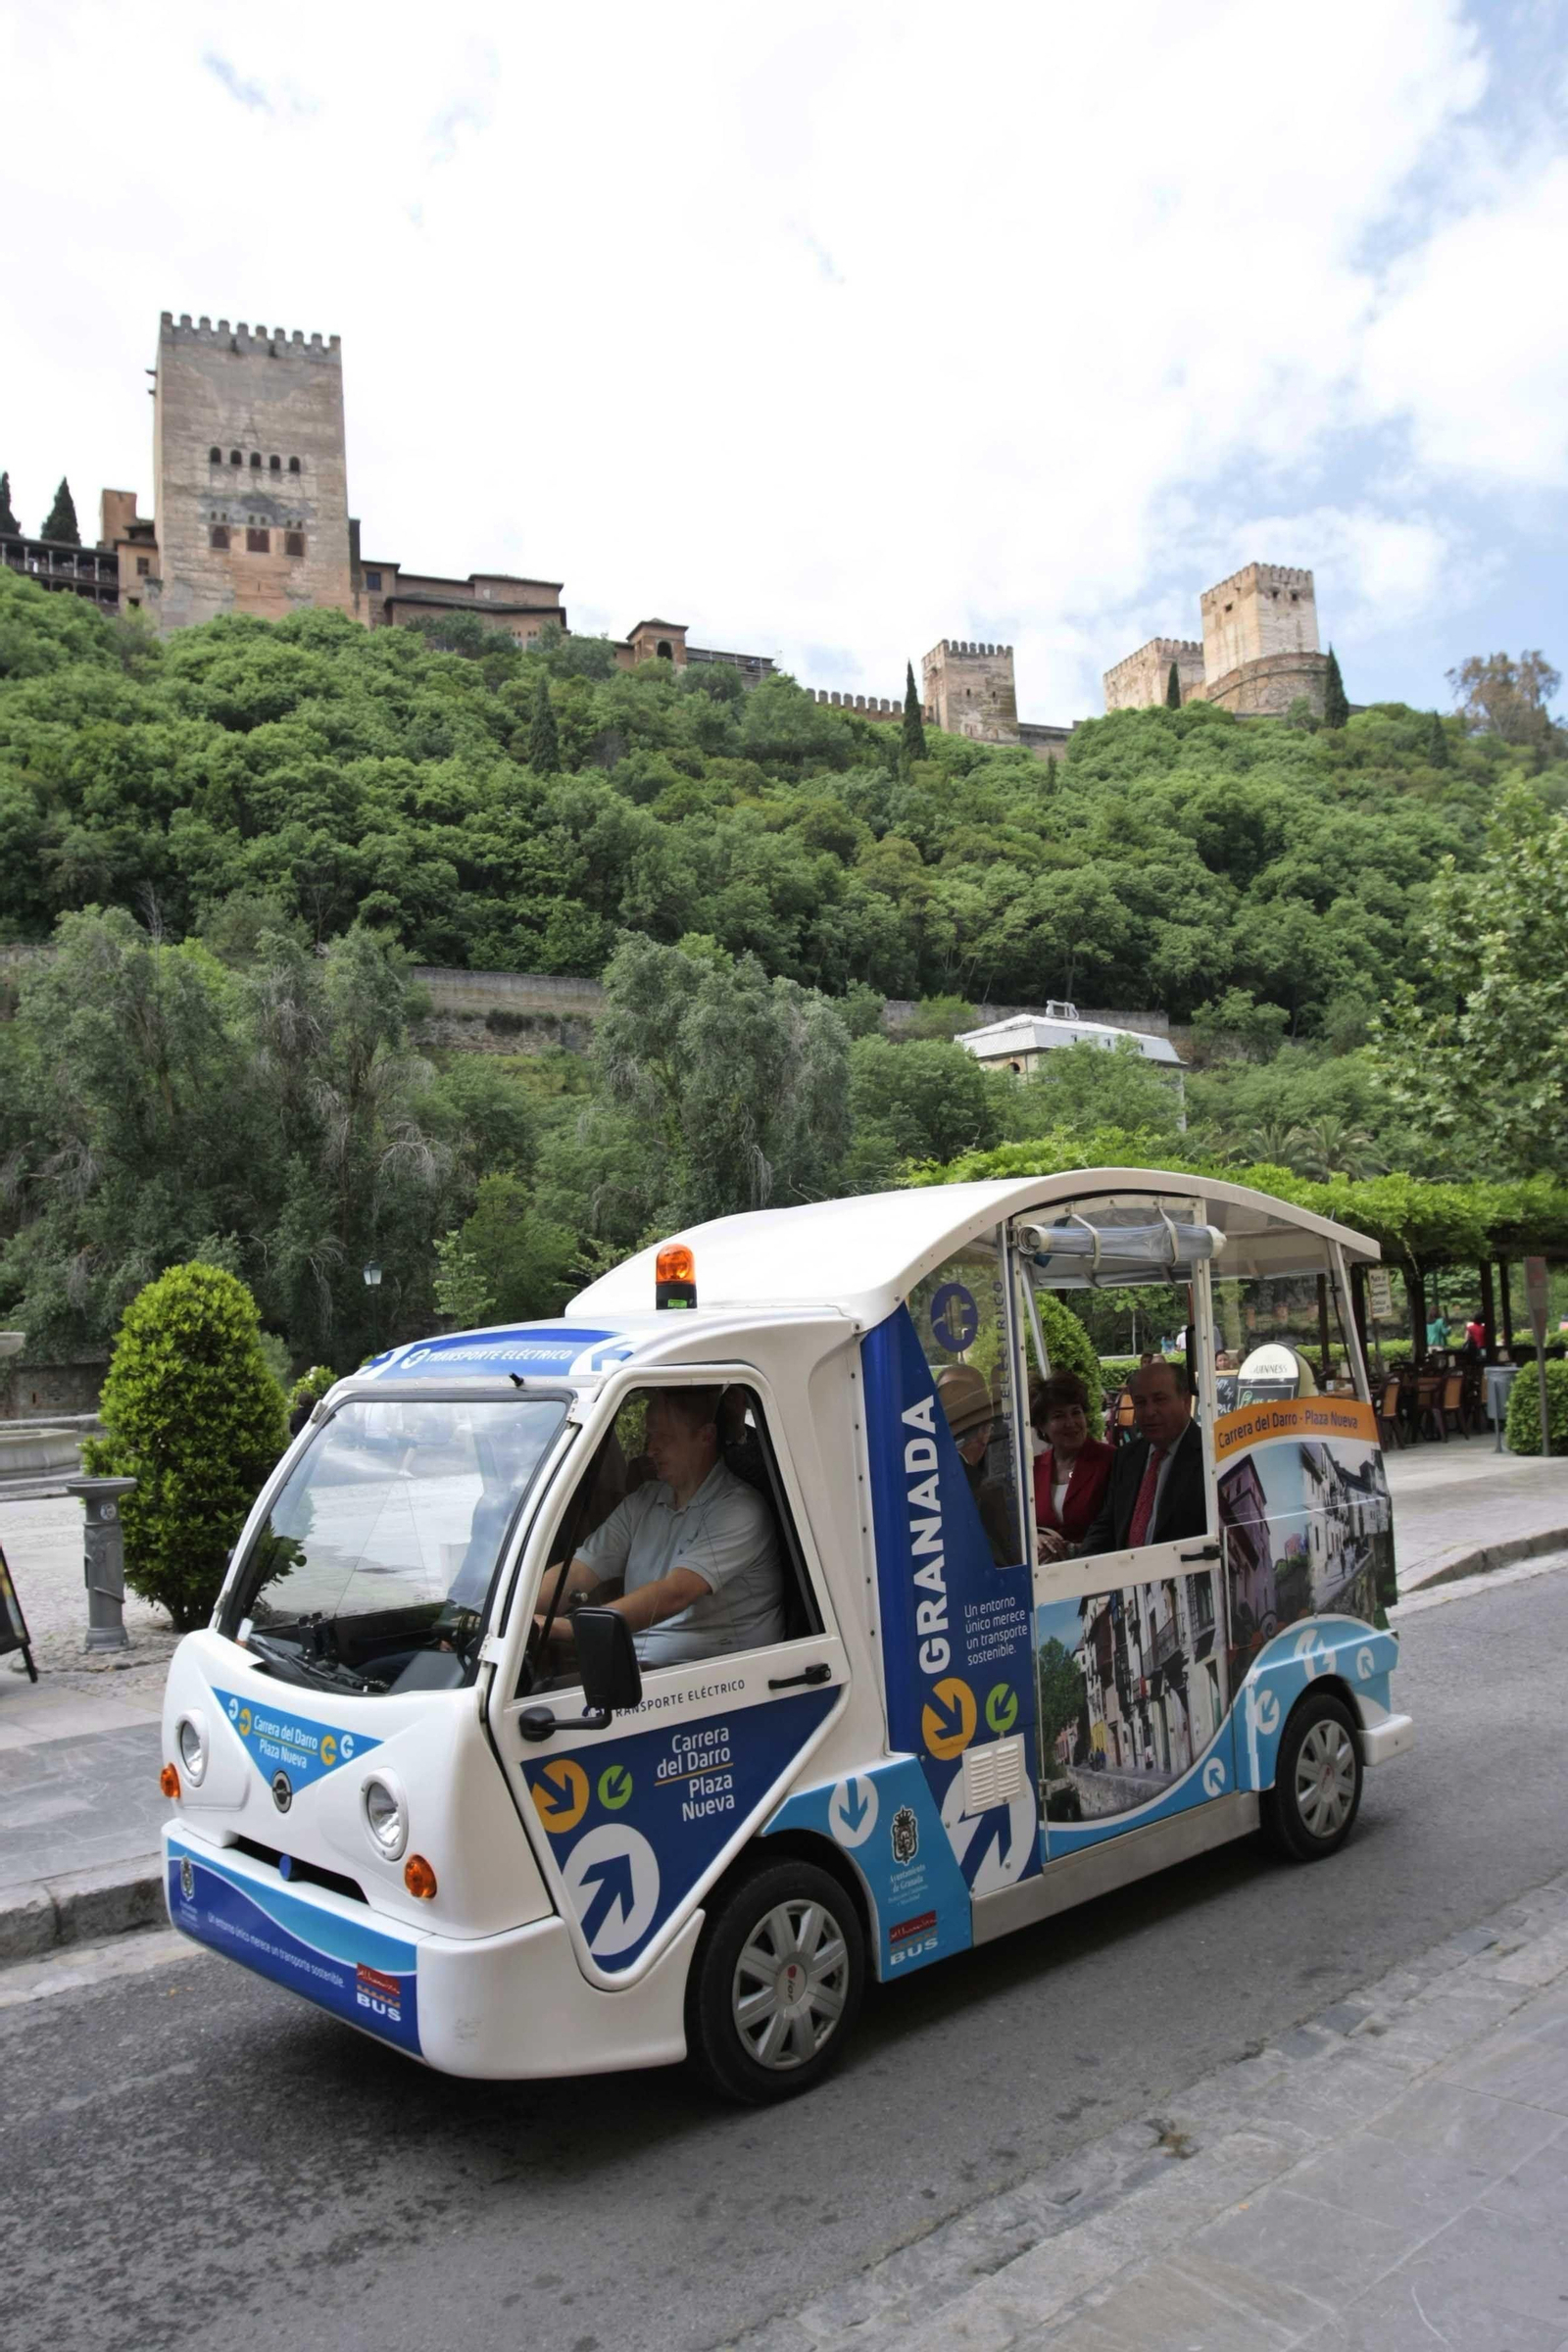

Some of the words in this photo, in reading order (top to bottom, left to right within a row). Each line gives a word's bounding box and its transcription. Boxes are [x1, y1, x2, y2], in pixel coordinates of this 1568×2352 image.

[426, 1349, 503, 1362] TRANSPORTE
[1217, 1422, 1253, 1448] Carrera
[1255, 1414, 1270, 1433] del
[1272, 1412, 1298, 1428] Darro
[1304, 1409, 1329, 1425] Plaza
[1330, 1412, 1358, 1430] Nueva
[902, 1395, 951, 1675] GRANADA
[964, 1604, 978, 1618] Un
[980, 1596, 1015, 1614] entorno
[965, 1619, 991, 1635] único
[993, 1610, 1026, 1627] merece
[966, 1638, 979, 1650] un
[981, 1624, 1028, 1646] transporte
[967, 1643, 1016, 1666] sostenible.
[614, 1692, 684, 1718] RANSPORTE
[687, 1679, 746, 1701] ELÉCTRICO
[254, 1715, 280, 1738] Carrera
[280, 1725, 294, 1741] del
[295, 1729, 318, 1750] Darro
[671, 1727, 729, 1754] Carrera
[259, 1739, 280, 1759] Plaza
[280, 1746, 308, 1770] Nueva
[657, 1754, 683, 1779] del
[687, 1747, 731, 1771] Darro
[689, 1774, 733, 1798] Plaza
[682, 1794, 735, 1822] Nueva
[890, 1937, 939, 1966] BUS
[356, 1991, 402, 2023] BUS
